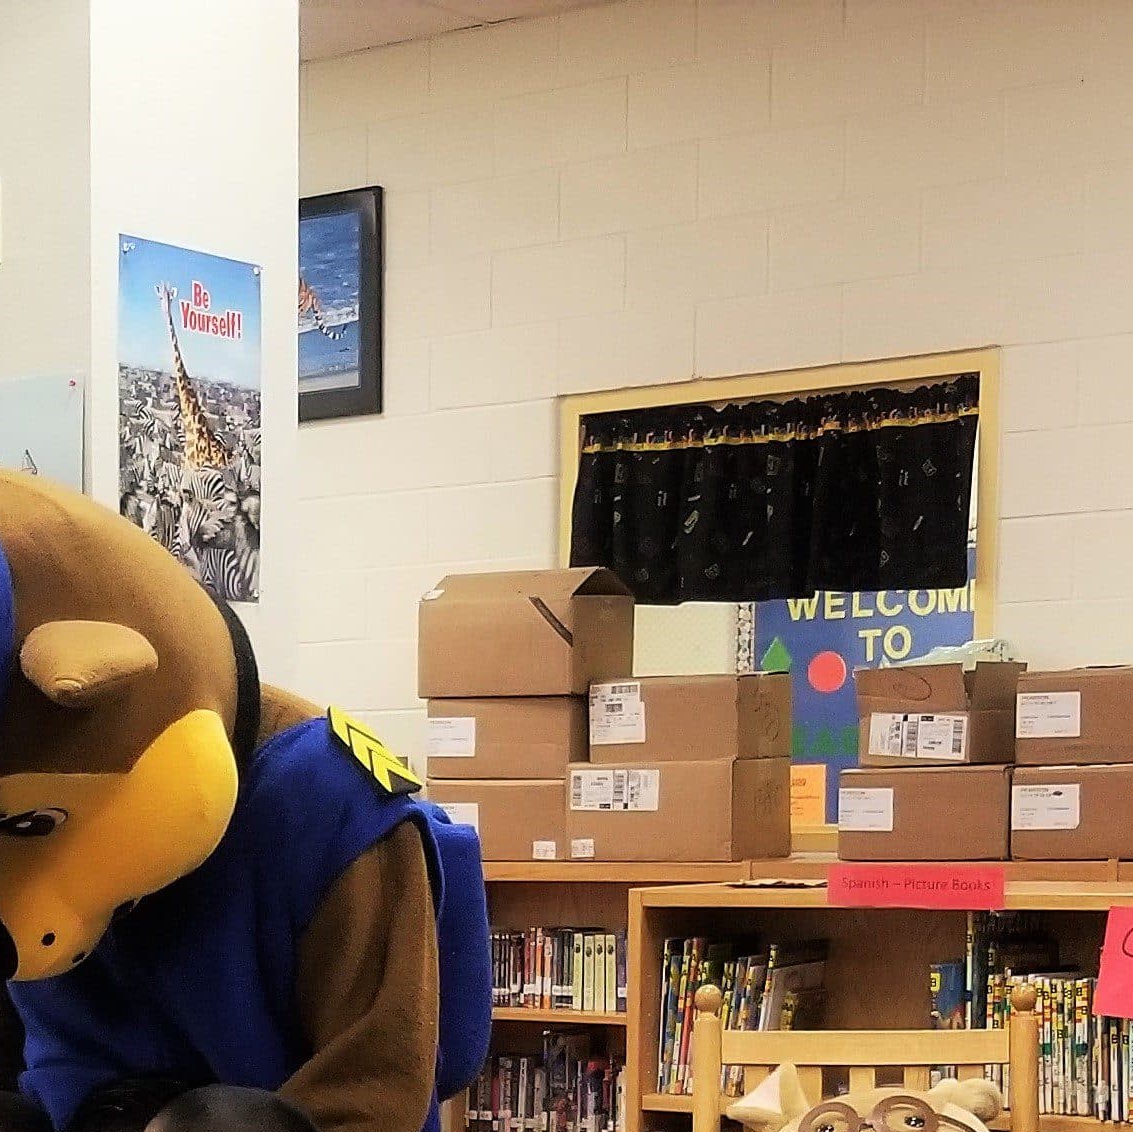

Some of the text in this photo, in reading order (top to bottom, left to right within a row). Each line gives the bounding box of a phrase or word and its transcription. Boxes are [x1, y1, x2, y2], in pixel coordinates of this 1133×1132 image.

[193, 282, 210, 309] Be
[180, 301, 242, 339] Yourself!
[858, 625, 912, 662] TO
[842, 877, 889, 890] Spanish
[904, 878, 948, 890] Picture
[952, 878, 991, 890] Books
